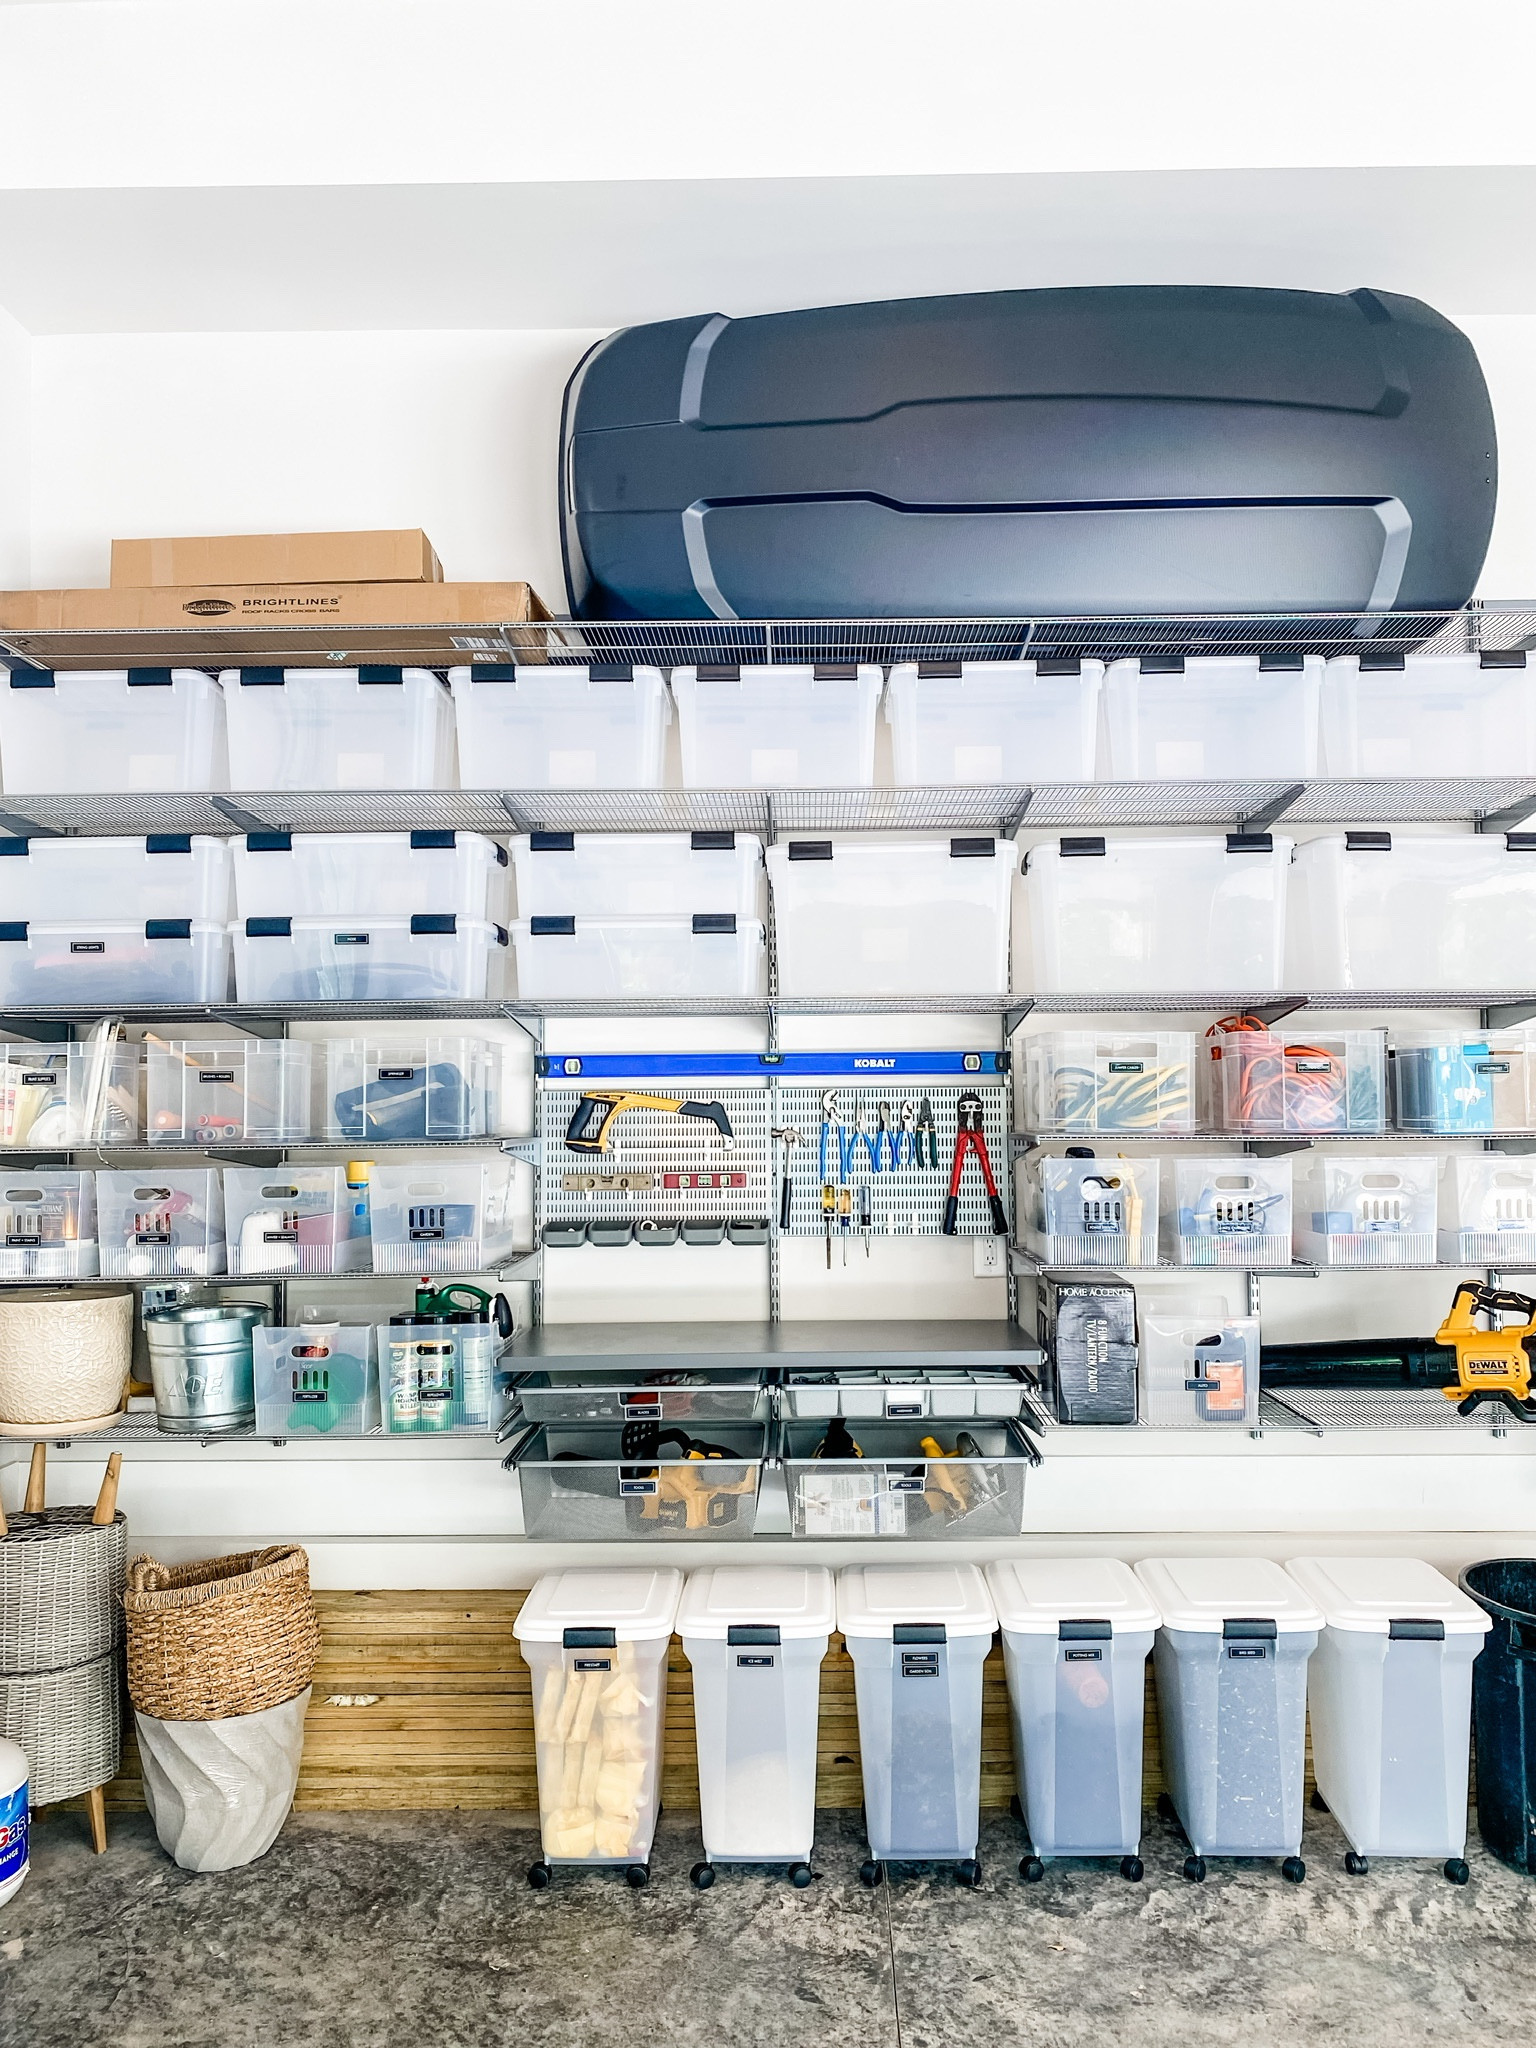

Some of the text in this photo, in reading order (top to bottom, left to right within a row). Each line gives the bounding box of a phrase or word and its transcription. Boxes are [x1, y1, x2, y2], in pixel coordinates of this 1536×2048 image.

[242, 598, 339, 606] BRIGHTLINES
[854, 1058, 896, 1068] KOBALT
[1058, 1287, 1131, 1297] HOME ACCENTS
[1098, 1327, 1109, 1363] FUNCTION
[1085, 1319, 1099, 1393] TV/LANTERN/RADIO
[168, 1373, 224, 1397] ACE
